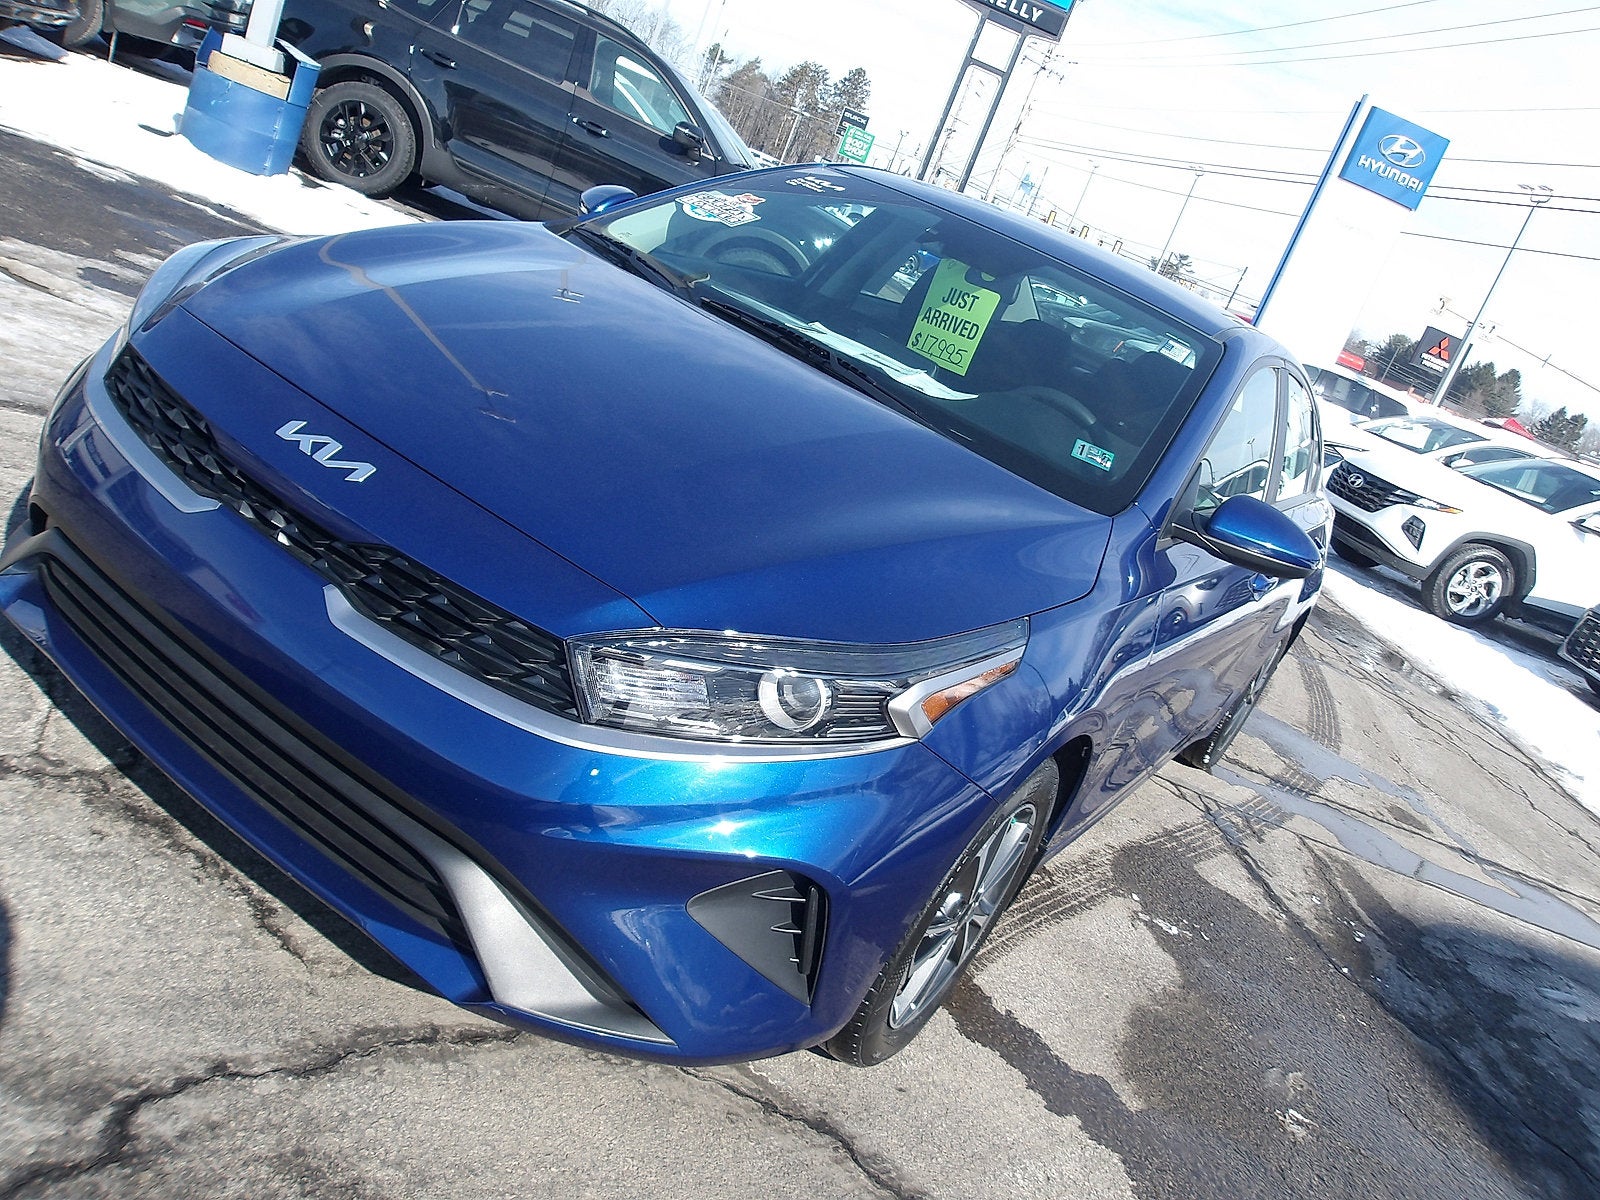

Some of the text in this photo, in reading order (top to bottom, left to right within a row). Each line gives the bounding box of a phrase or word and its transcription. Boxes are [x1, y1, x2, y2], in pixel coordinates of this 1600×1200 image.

[1357, 155, 1424, 192] HYUNDAI
[942, 287, 980, 312] JUST
[921, 306, 980, 341] ARRIVED
[275, 420, 377, 482] KIA
